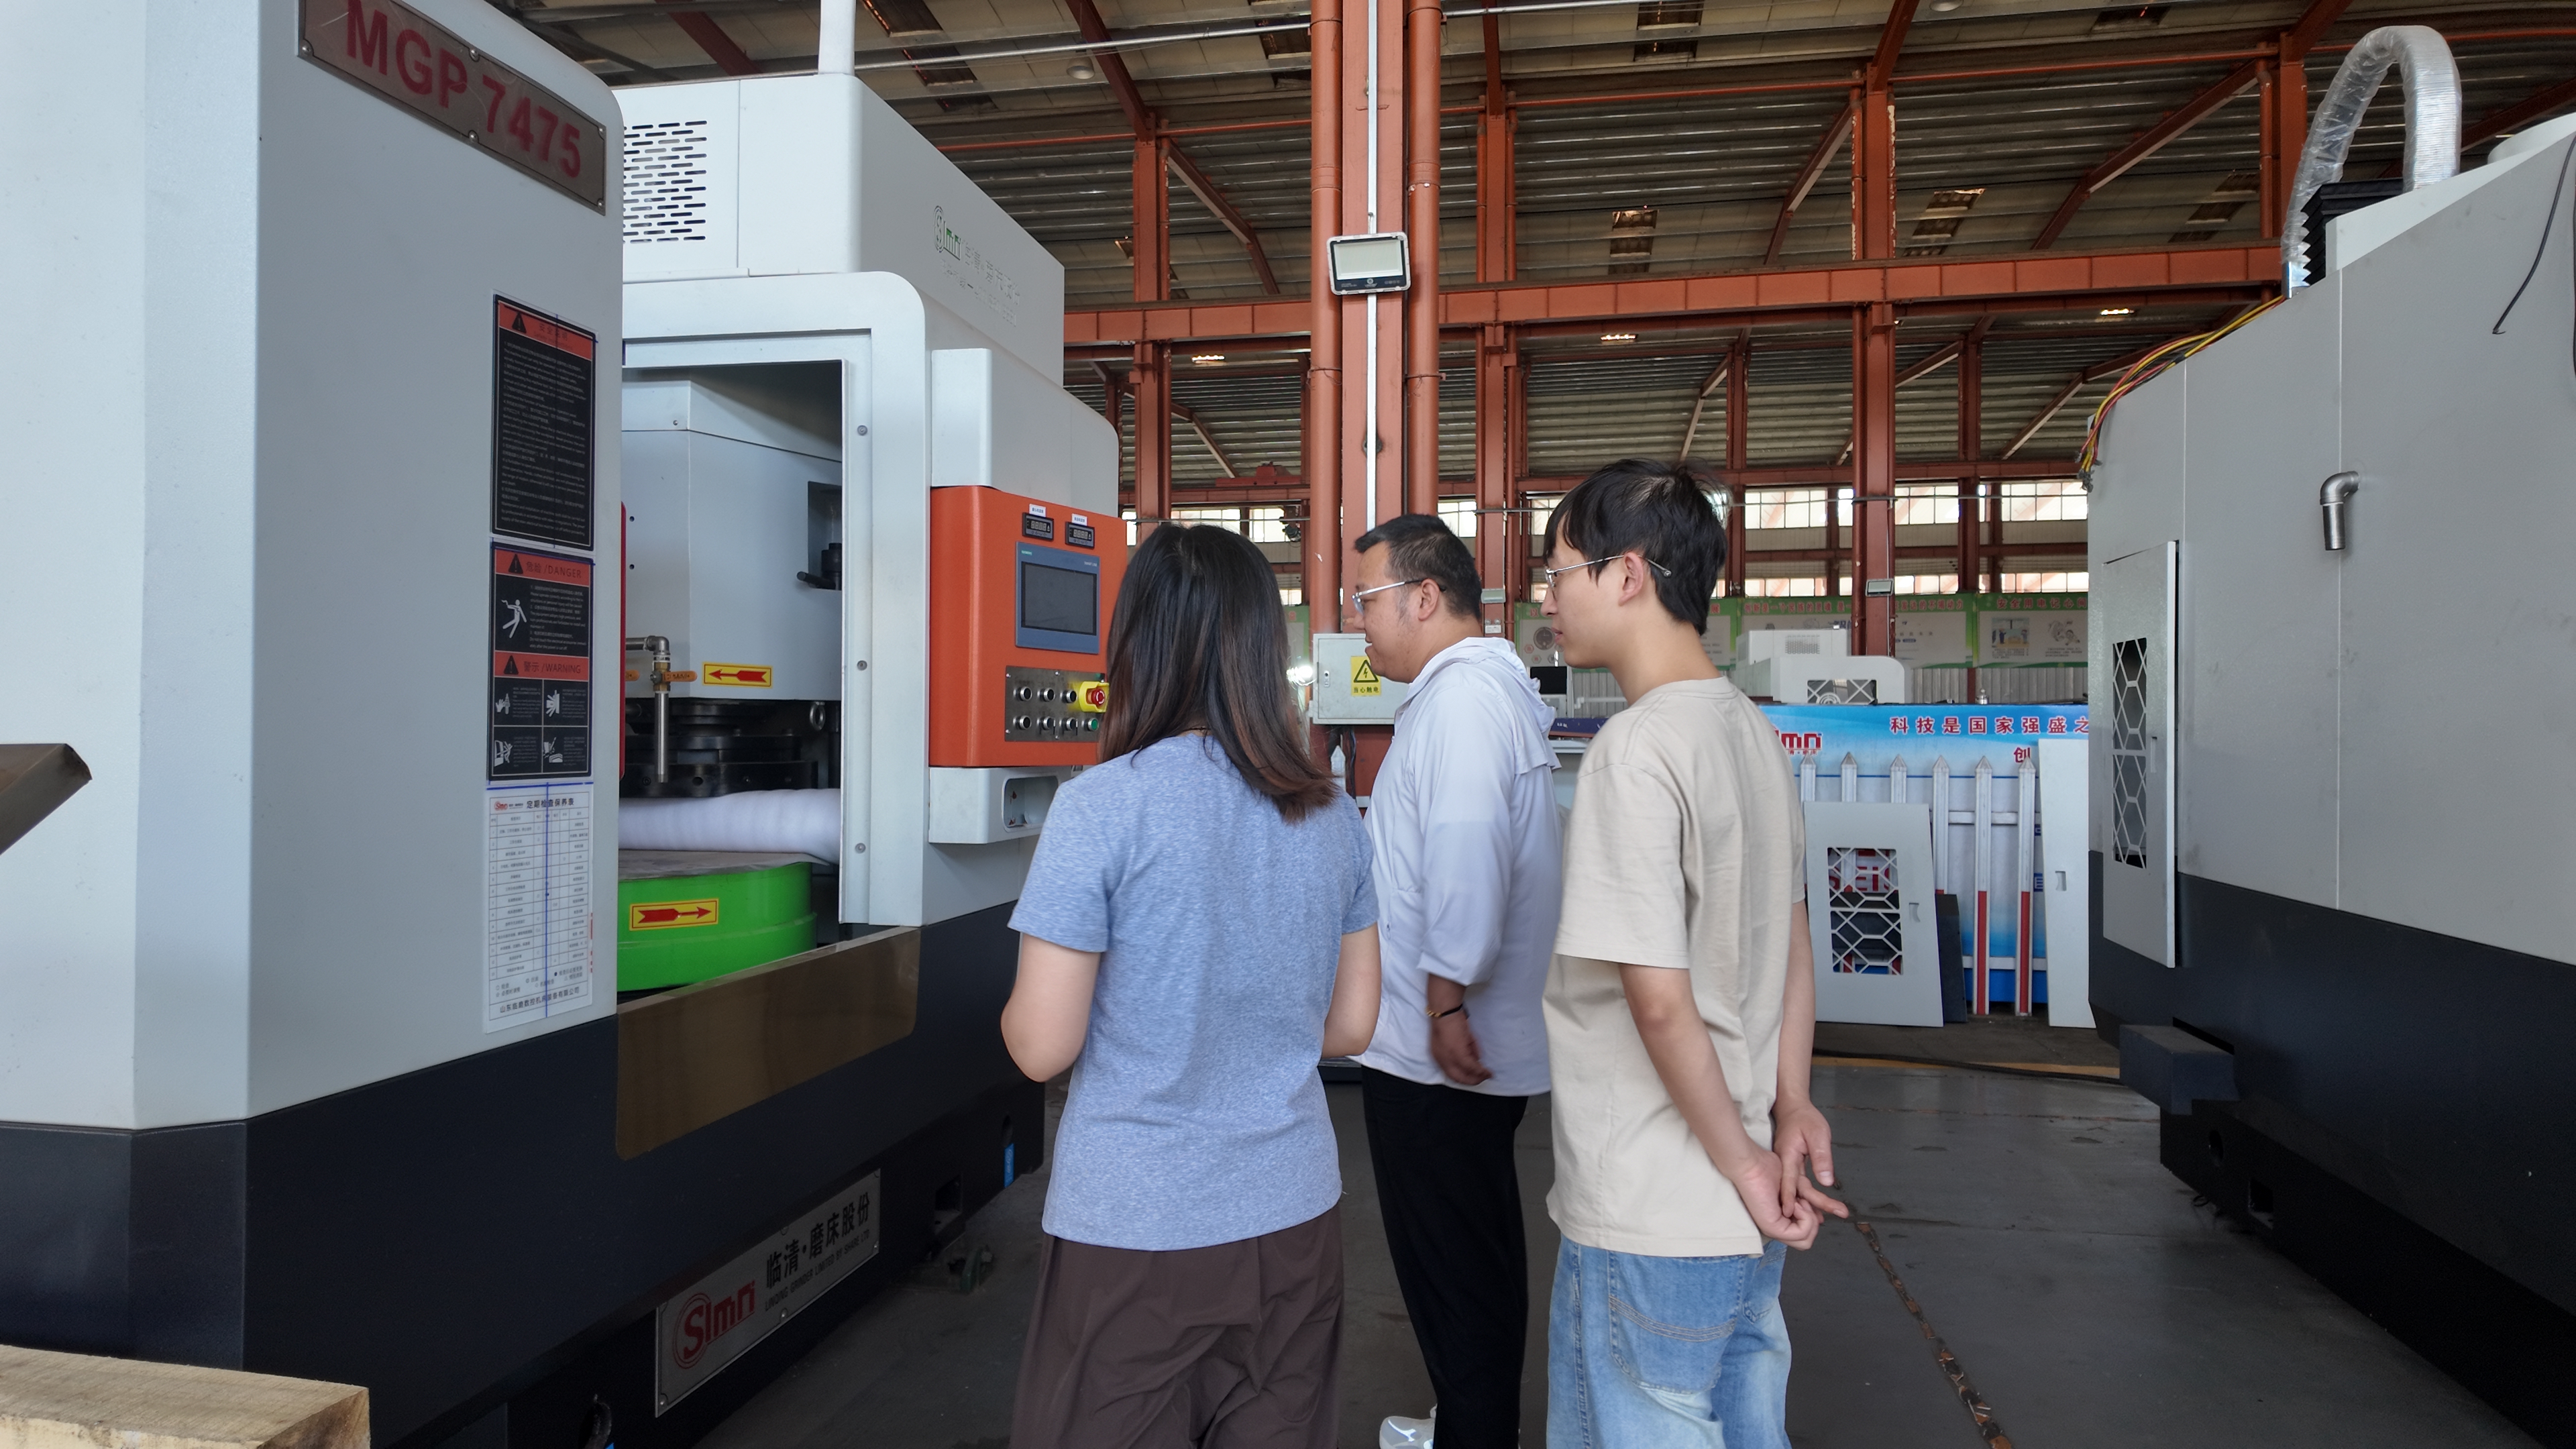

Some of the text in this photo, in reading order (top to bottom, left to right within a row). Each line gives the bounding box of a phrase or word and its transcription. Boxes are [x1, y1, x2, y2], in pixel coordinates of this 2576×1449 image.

[347, 0, 581, 178] MGP 7475
[526, 561, 582, 578] 危险 /DANGER
[541, 663, 581, 674] /WARNING
[1890, 716, 2088, 735] 科技是国家强盛之
[766, 1191, 870, 1289] 临清·磨床股份
